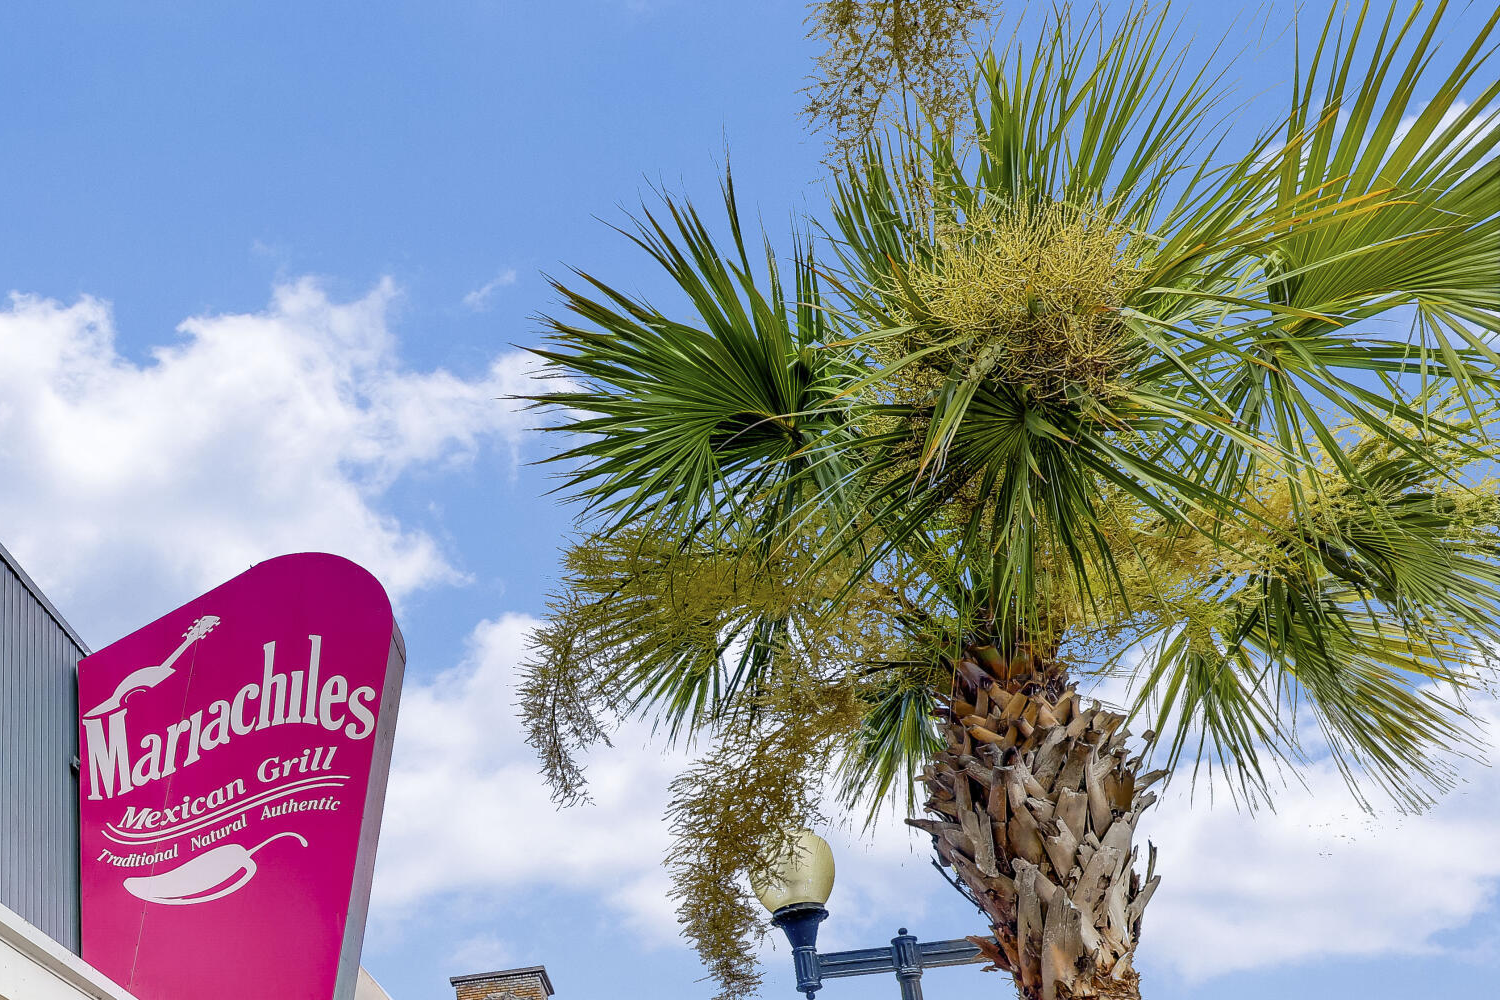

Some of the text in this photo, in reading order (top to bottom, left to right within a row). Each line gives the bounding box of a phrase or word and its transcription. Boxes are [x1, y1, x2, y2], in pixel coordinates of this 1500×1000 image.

[83, 634, 376, 801] Mariachiles
[117, 746, 337, 830] Mexican Grill
[96, 795, 341, 867] Traditional Natural Authentic
